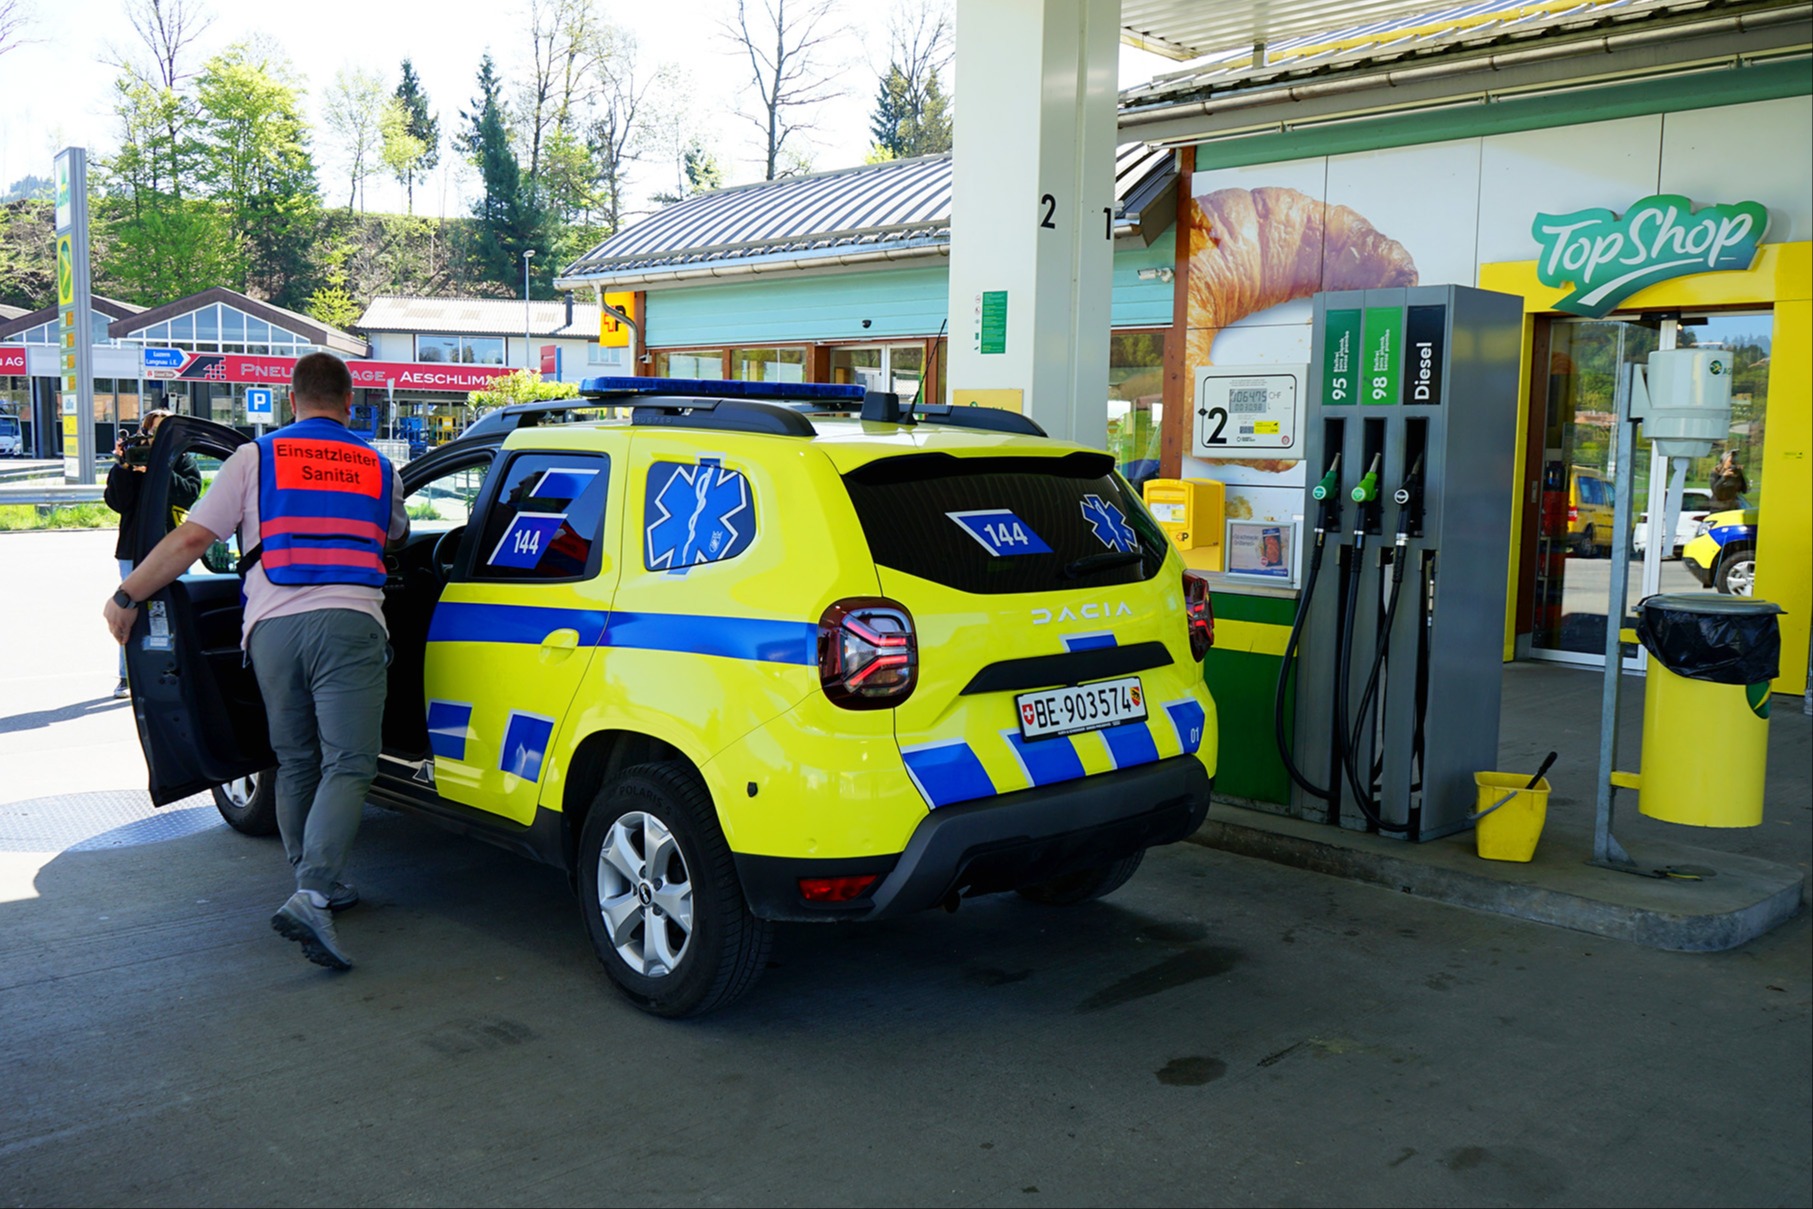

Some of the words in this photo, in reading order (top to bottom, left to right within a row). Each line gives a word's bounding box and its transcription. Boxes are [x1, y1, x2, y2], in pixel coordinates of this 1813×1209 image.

[1040, 193, 1056, 229] 2
[1103, 207, 1111, 240] 1
[5, 356, 24, 367] AG
[1414, 342, 1432, 400] Diesel
[1332, 378, 1347, 400] 95
[1372, 376, 1388, 400] 98
[254, 393, 266, 410] P
[1207, 406, 1228, 444] 2
[276, 444, 377, 467] Einsatzleiter
[302, 465, 361, 485] Sanität
[514, 529, 541, 554] 144
[983, 522, 1029, 547] 144
[1031, 601, 1132, 625] DACIA
[1190, 727, 1200, 743] 01
[619, 784, 664, 808] POLARIS
